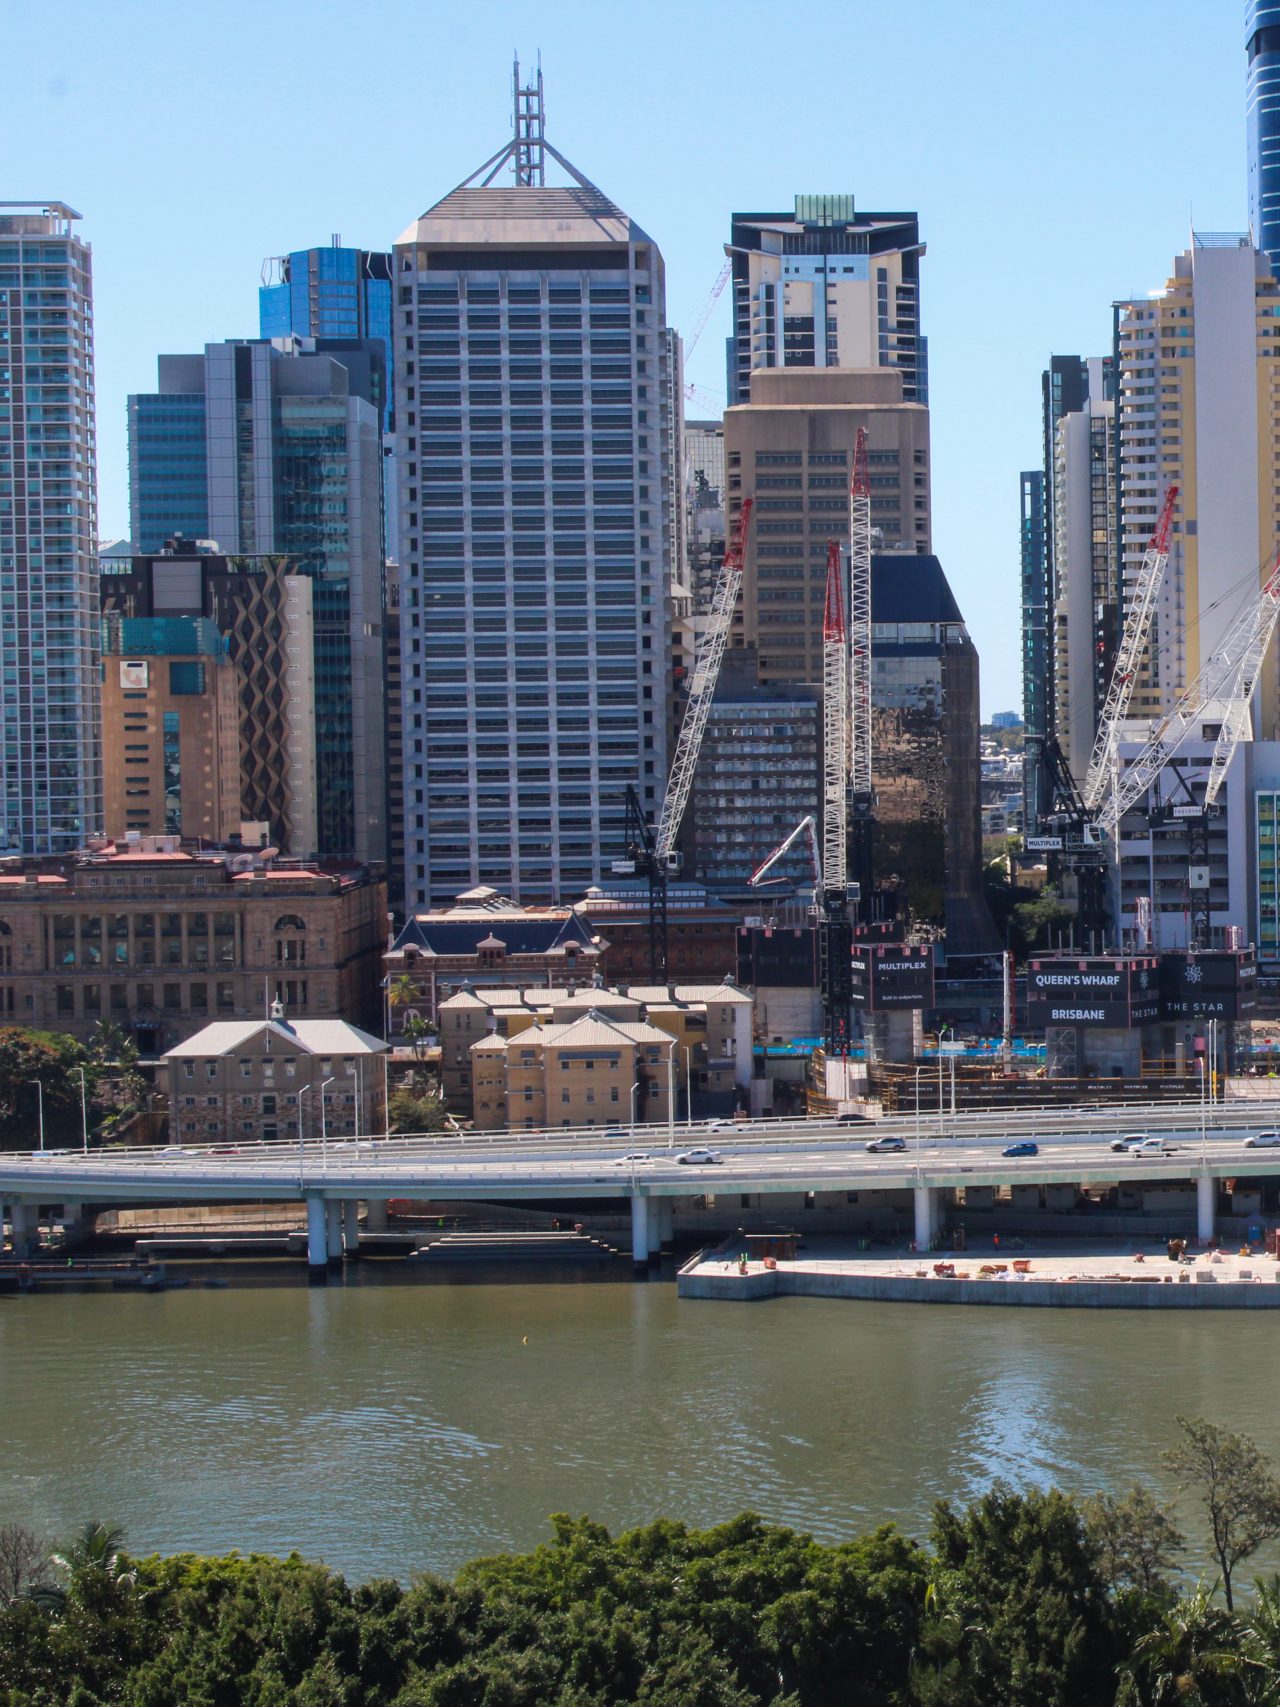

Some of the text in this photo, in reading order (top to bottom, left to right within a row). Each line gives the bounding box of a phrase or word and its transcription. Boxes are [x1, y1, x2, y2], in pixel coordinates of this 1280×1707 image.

[878, 961, 927, 970] MULTIPLEX
[1035, 975, 1120, 987] QUEEN'S WHARF
[1166, 1002, 1223, 1011] THE STAR
[1051, 1009, 1105, 1020] BRISBANE
[1131, 1007, 1158, 1019] THE STAR
